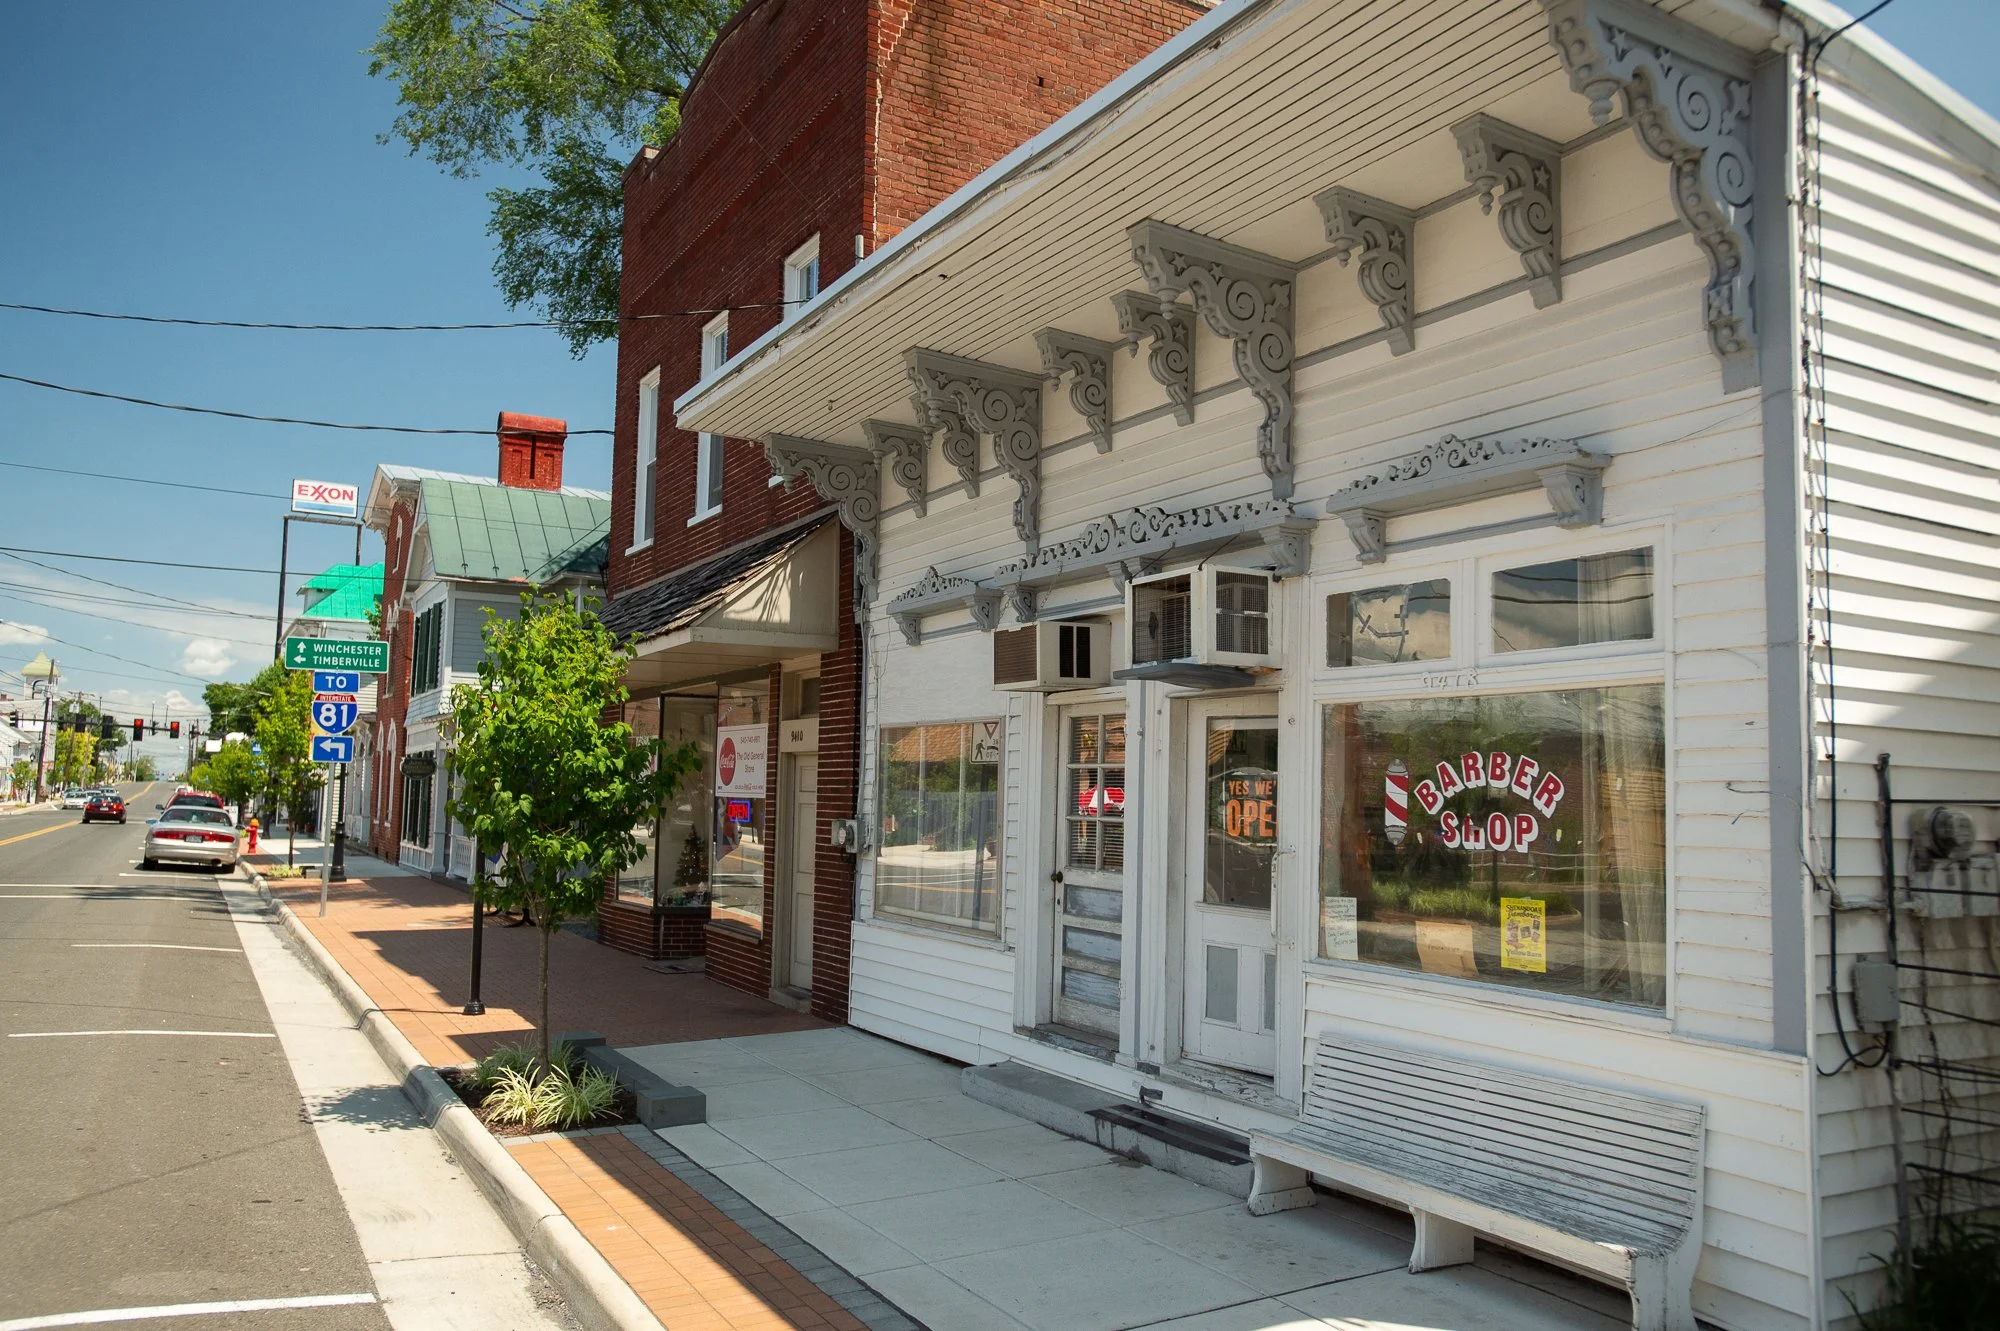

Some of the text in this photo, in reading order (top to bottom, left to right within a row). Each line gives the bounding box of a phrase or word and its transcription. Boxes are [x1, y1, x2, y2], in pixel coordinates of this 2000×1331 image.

[298, 484, 353, 503] EXXON
[313, 643, 381, 655] WINCHESTER
[313, 656, 380, 667] TIMBERVILLE
[325, 676, 347, 689] TO
[319, 694, 351, 702] INTERSTATE
[319, 703, 348, 728] 81
[750, 750, 764, 760] General
[1228, 779, 1250, 796] YES
[1414, 751, 1565, 819] BARBER
[728, 804, 747, 818] OPEN
[1226, 800, 1278, 837] OPE
[1440, 811, 1539, 853] SHOP
